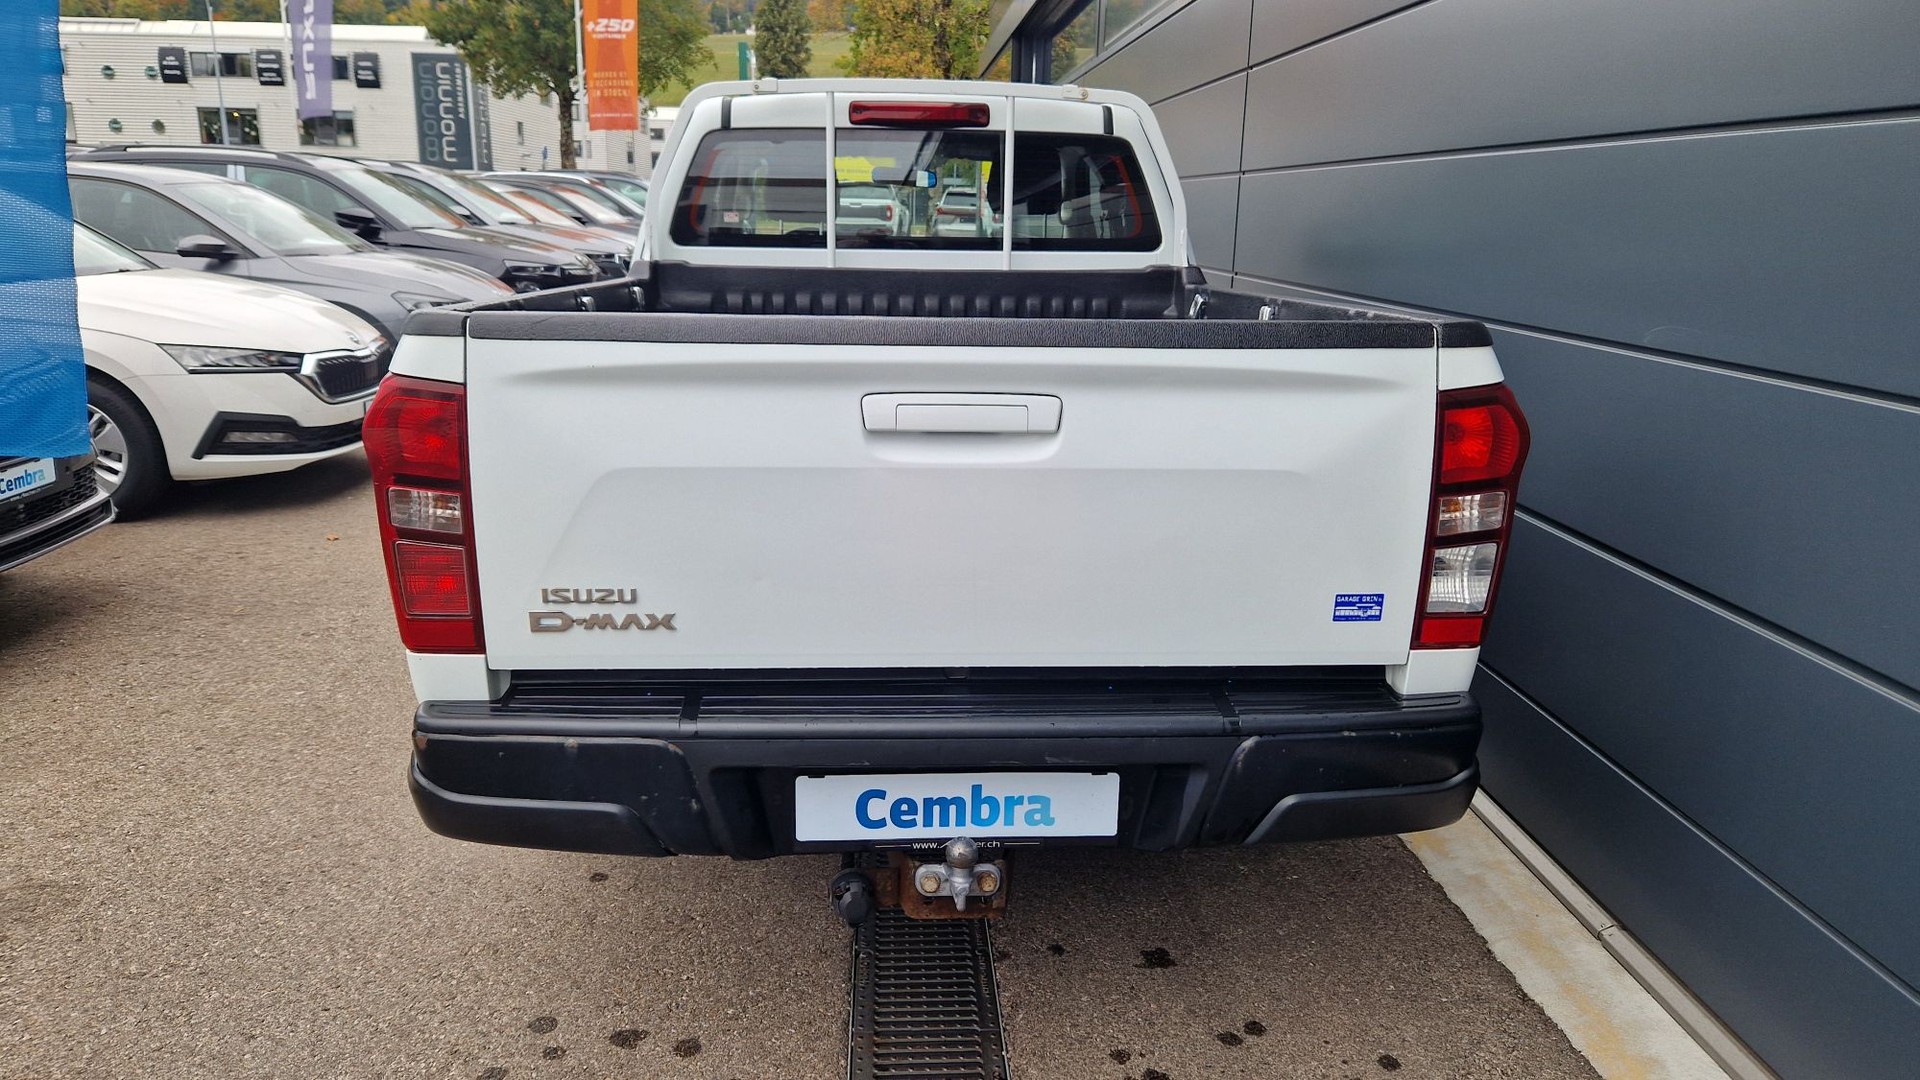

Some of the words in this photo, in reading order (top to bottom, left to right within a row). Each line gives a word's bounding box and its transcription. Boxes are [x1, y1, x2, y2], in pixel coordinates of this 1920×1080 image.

[587, 18, 635, 32] +250
[435, 62, 457, 163] monnin
[0, 469, 46, 495] Cembra
[541, 588, 638, 604] ISUZU
[528, 610, 678, 633] D-MAX
[855, 784, 1056, 829] Cembra
